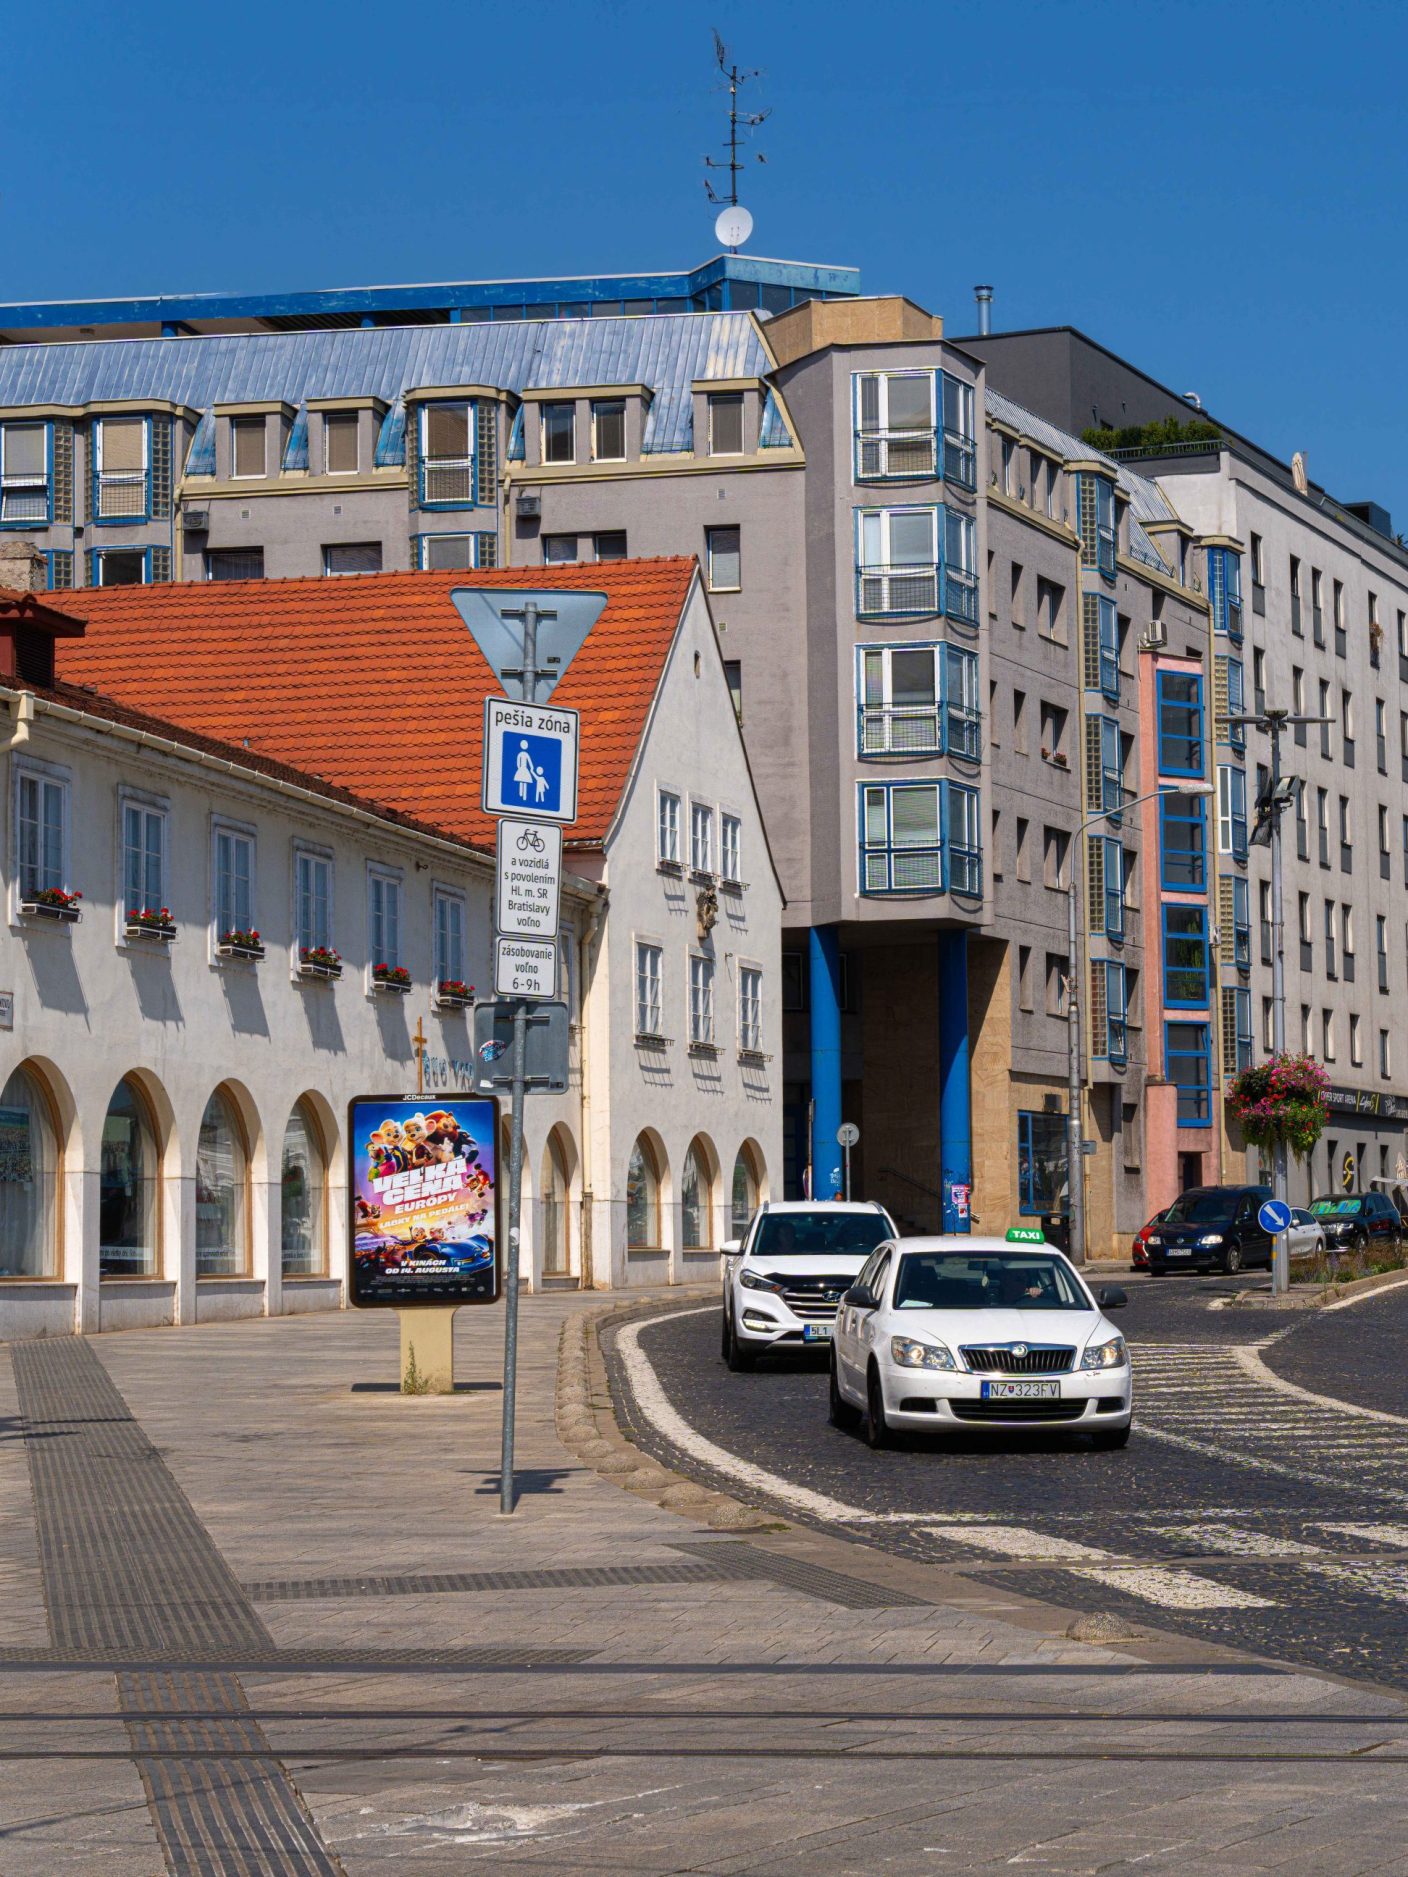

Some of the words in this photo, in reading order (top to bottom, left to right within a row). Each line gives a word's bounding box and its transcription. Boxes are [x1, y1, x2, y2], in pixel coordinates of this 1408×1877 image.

[496, 709, 533, 728] pešia
[538, 715, 570, 734] zóna
[511, 857, 516, 866] a
[519, 857, 549, 869] vozidlá
[504, 872, 509, 880] s
[511, 872, 555, 885] povolením
[511, 885, 522, 896] Hl.
[525, 889, 535, 898] m.
[537, 887, 548, 899] SR
[508, 899, 551, 916] Bratislavy
[517, 916, 541, 928] voľno
[501, 944, 552, 960] zásobovanie
[515, 961, 539, 974] voľno
[373, 1155, 467, 1193] VEĽKÁ
[382, 1174, 463, 1206] CENA
[394, 1191, 458, 1214] EURÓPY
[1012, 1230, 1040, 1240] TAXI
[414, 1266, 460, 1274] AUGUSTA
